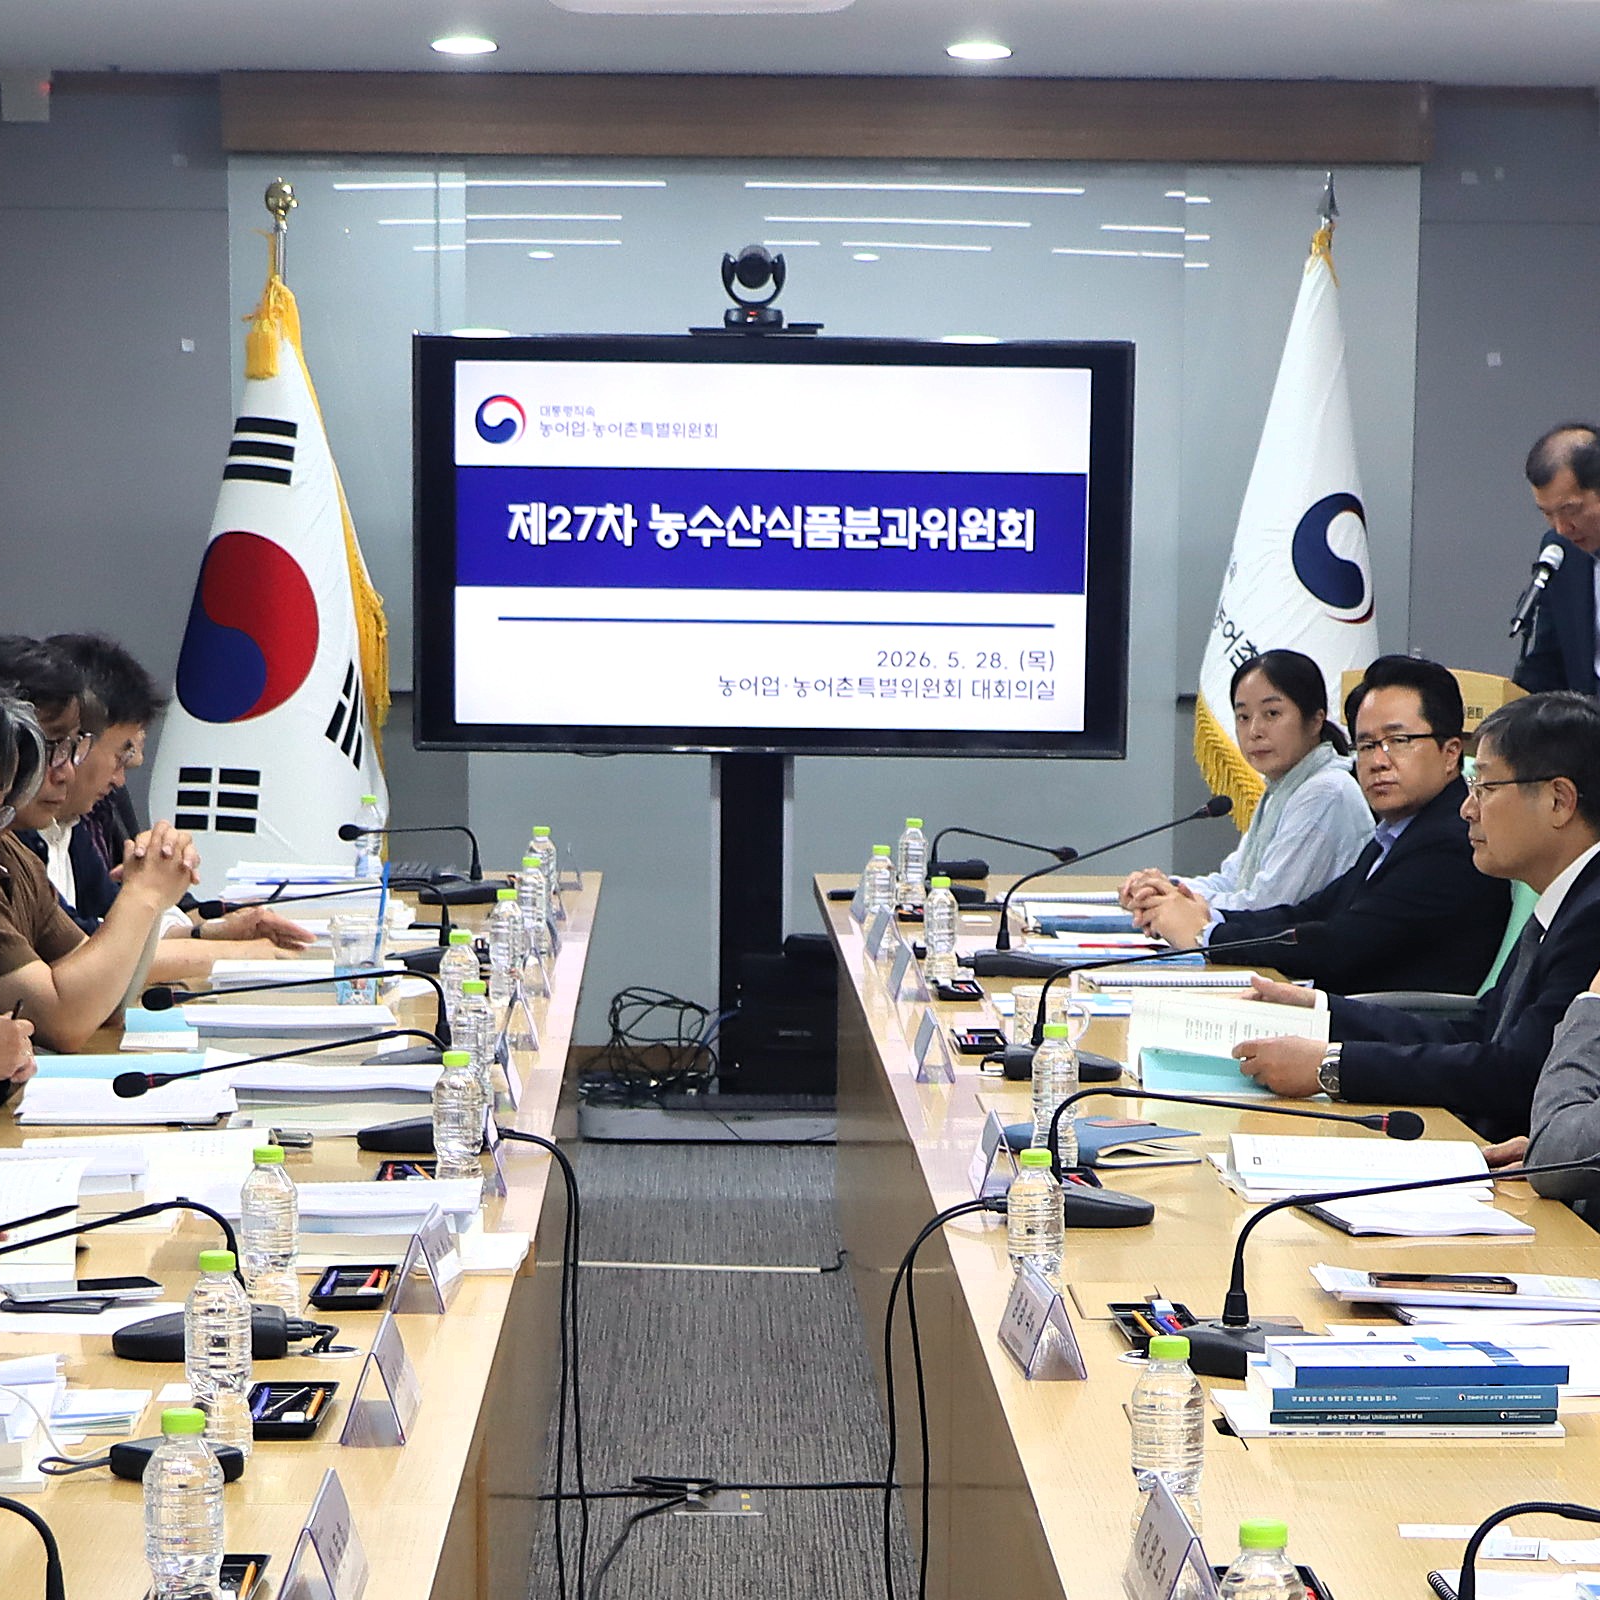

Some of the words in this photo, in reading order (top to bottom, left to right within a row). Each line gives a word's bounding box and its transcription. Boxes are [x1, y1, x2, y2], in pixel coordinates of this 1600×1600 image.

[539, 406, 596, 418] 대통령직속
[538, 420, 719, 440] 농어업·농어촌특별위원회
[507, 501, 637, 548] 제27차
[648, 502, 1036, 552] 농수산식품분과위원회
[876, 650, 939, 670] 2026.
[946, 651, 968, 671] 5.
[976, 651, 1010, 671] 28.
[1018, 649, 1055, 673] (목)
[717, 674, 962, 701] 농어업·농어촌특별위원회
[970, 677, 1056, 702] 대회의실
